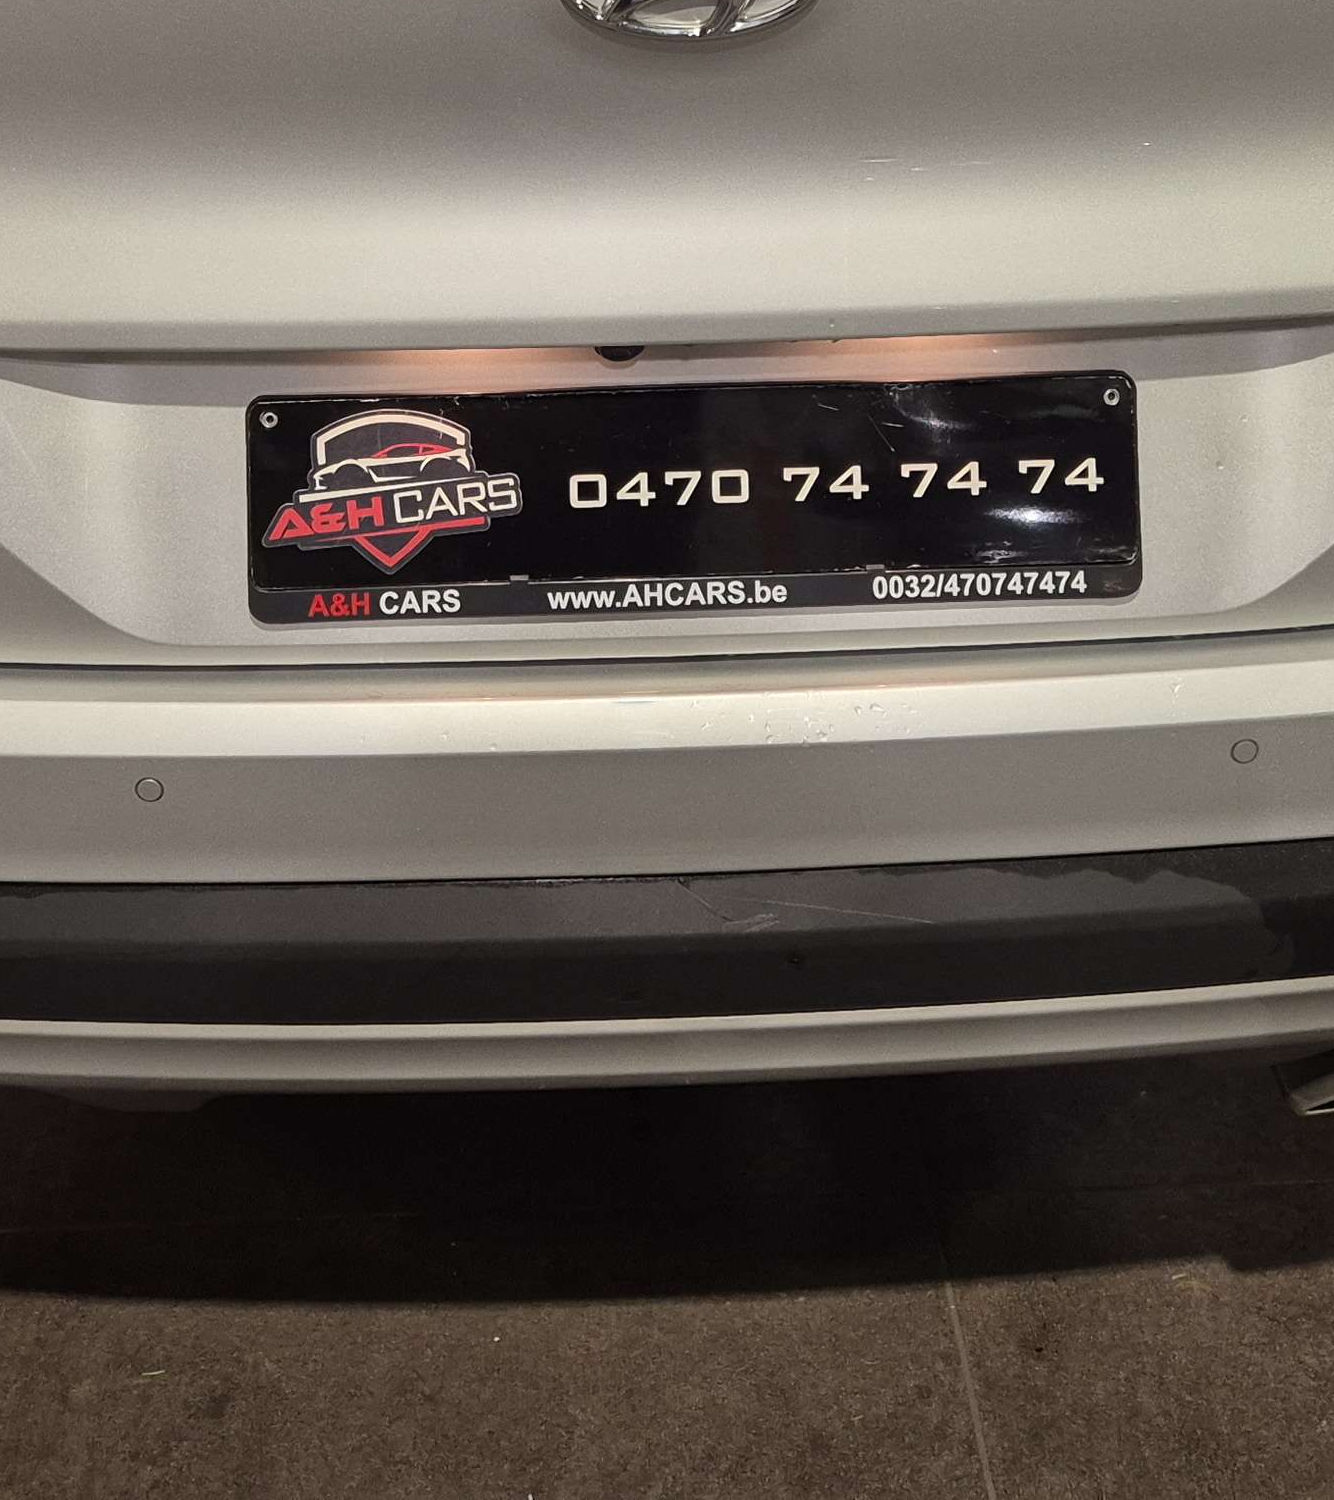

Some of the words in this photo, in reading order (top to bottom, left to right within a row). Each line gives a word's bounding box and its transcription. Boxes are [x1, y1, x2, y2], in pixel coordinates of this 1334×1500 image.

[570, 469, 749, 508] 0470
[783, 465, 869, 501] 74
[900, 461, 987, 498] 74
[1018, 457, 1104, 494] 74
[269, 496, 384, 541] A&H
[393, 477, 518, 523] CARS
[547, 580, 787, 609] www.AHCARS.be
[872, 570, 1087, 599] 0032/470747474
[308, 592, 371, 617] A&H
[379, 589, 461, 615] CARS
